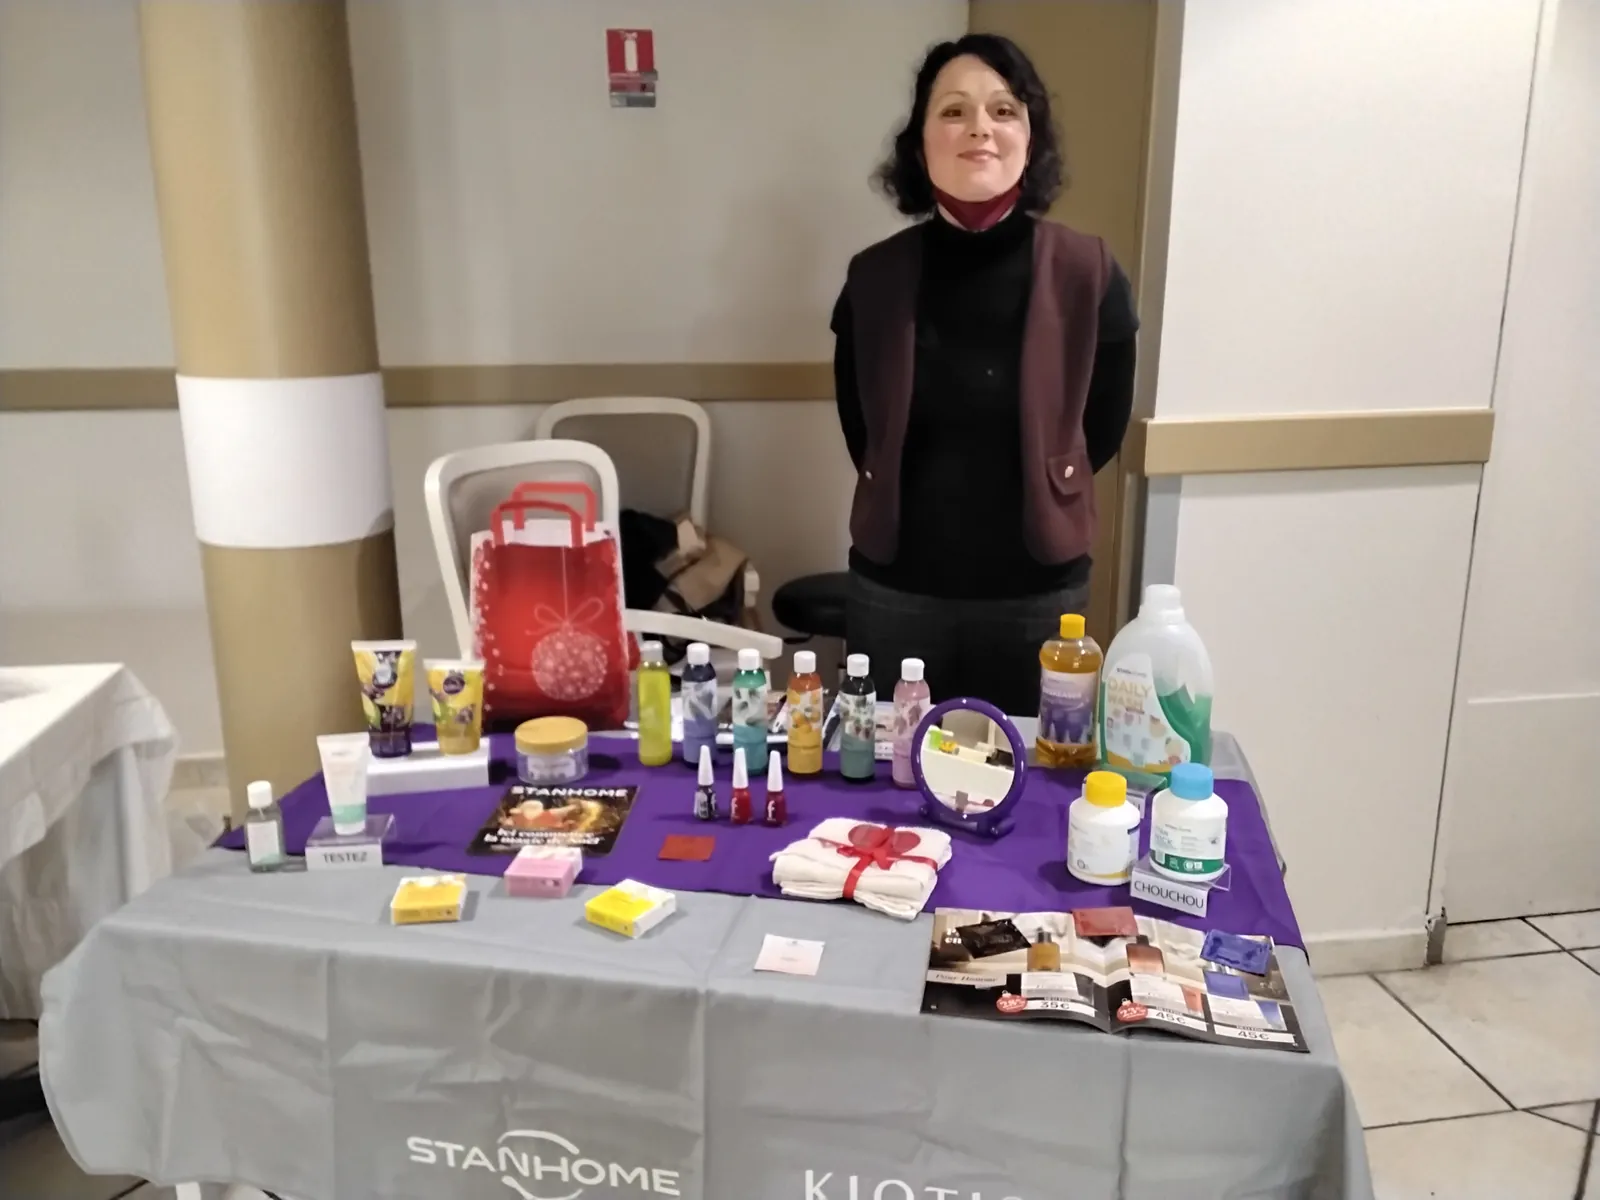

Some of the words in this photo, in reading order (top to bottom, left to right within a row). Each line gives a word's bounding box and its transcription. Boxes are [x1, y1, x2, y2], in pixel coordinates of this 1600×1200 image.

[1108, 677, 1152, 699] DAILY
[511, 785, 628, 797] STANHOME
[322, 851, 368, 864] TESTEZ
[1134, 880, 1204, 909] CHOUCHOU
[1040, 1001, 1070, 1010] 35€
[1155, 1011, 1187, 1025] 45€
[1237, 1029, 1270, 1041] 45€
[406, 1136, 681, 1197] STANHOME
